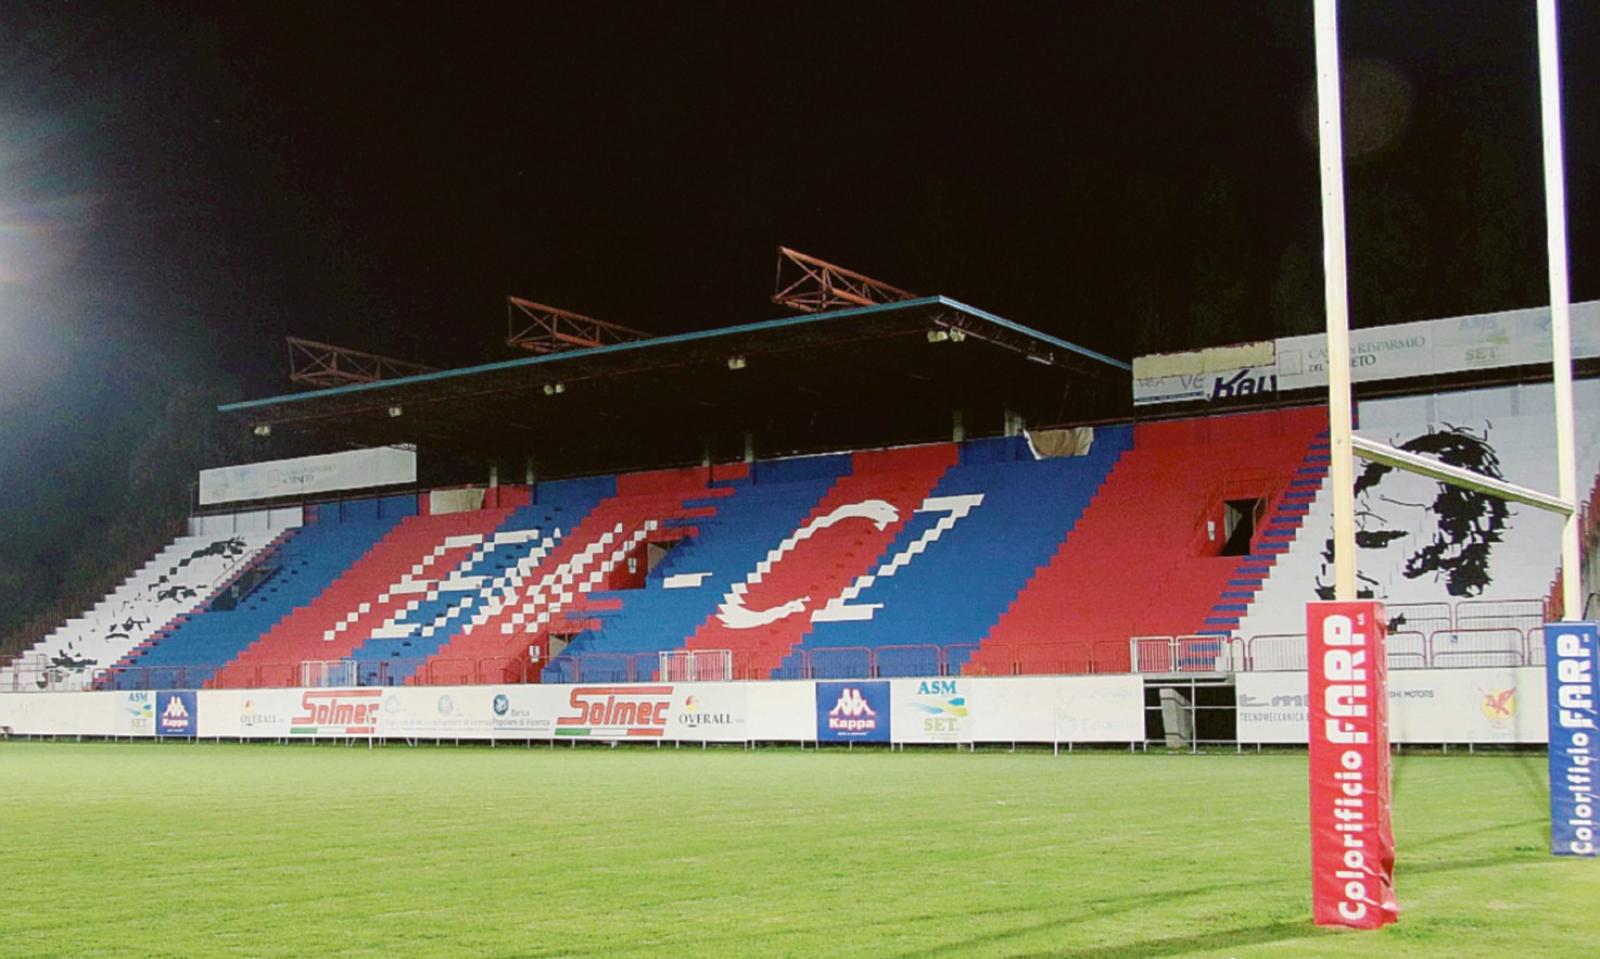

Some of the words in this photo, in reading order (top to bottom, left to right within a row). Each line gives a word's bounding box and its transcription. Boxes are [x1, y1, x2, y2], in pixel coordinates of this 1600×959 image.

[918, 680, 957, 694] ASM
[1323, 613, 1369, 744] FARP
[1556, 634, 1593, 728] FARP
[128, 692, 148, 702] ASM
[291, 690, 383, 725] Solmec
[556, 686, 674, 725] Solmec
[162, 718, 189, 727] Kappa
[679, 714, 733, 725] OVERALL
[829, 718, 876, 730] Kappa
[1566, 732, 1593, 855] Colorificio
[1335, 750, 1367, 921] Colorificio
